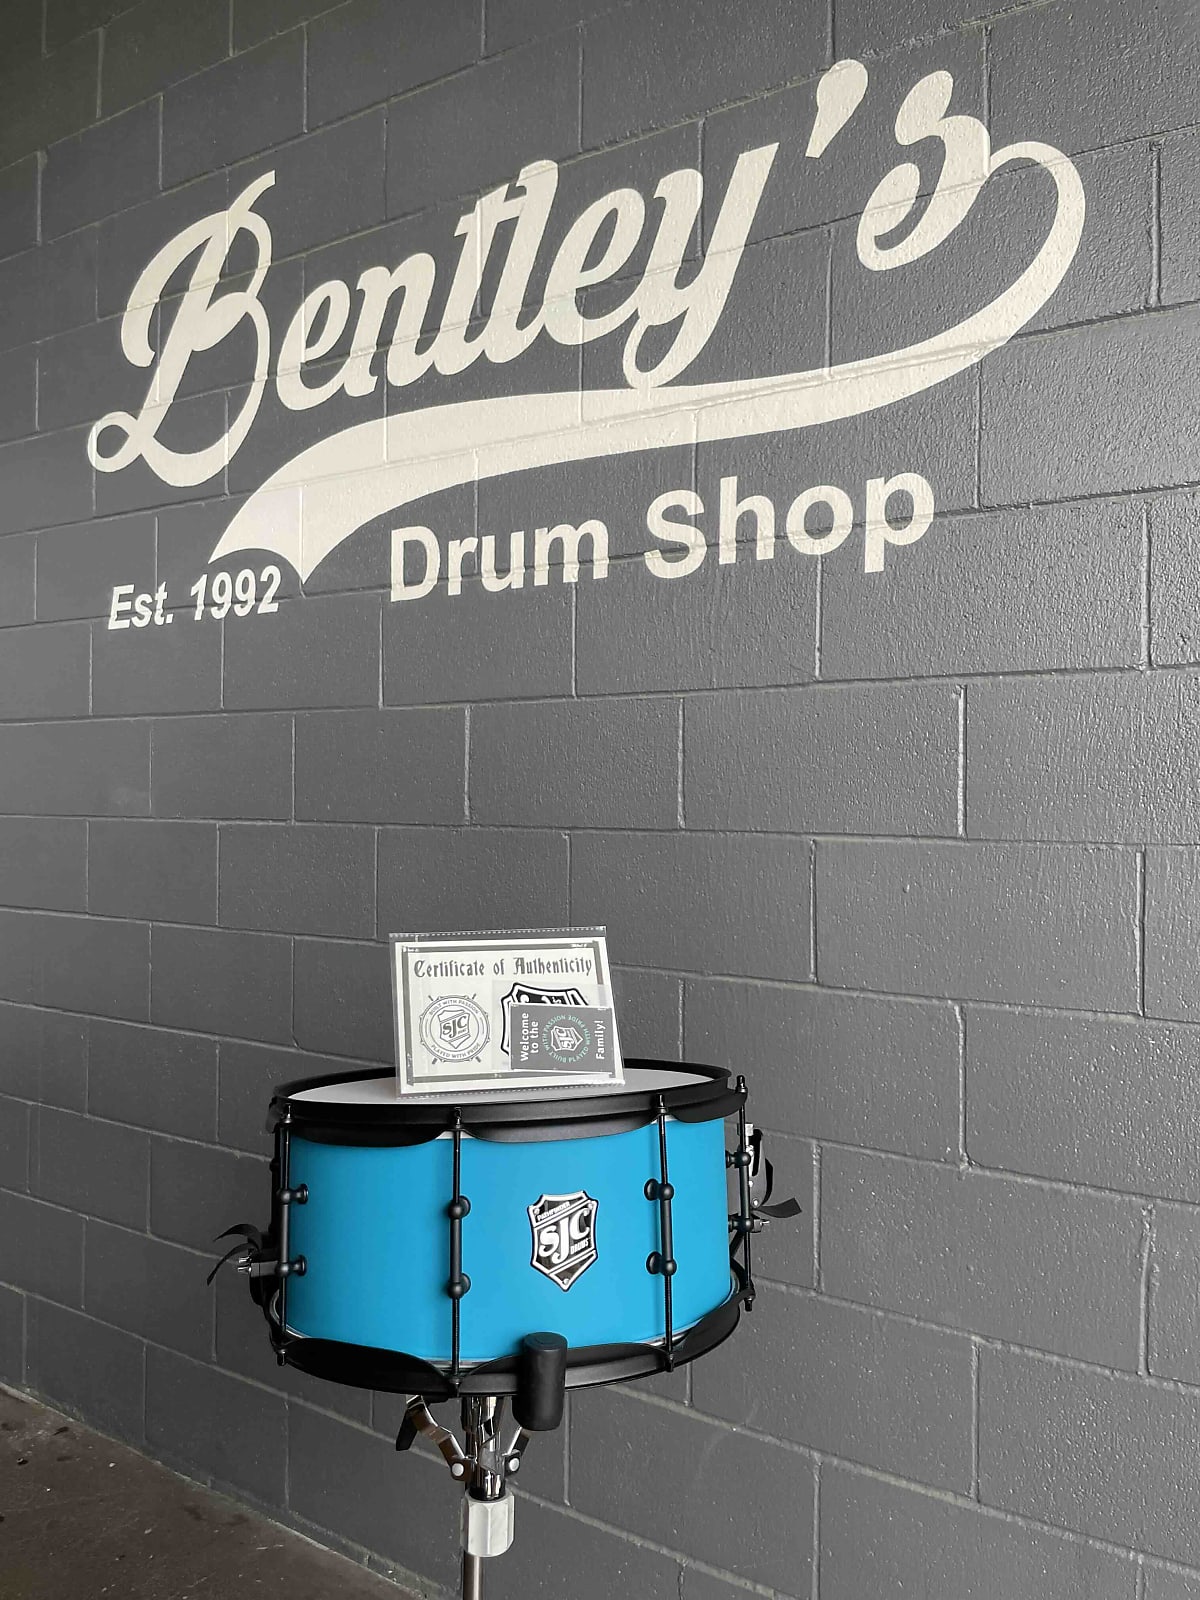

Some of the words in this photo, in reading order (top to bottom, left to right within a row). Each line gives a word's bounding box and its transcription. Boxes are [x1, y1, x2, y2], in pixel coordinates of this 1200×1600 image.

[87, 58, 1085, 487] Bentley's
[391, 519, 610, 603] Drum
[644, 470, 935, 580] Shop
[107, 581, 173, 631] Est.
[190, 565, 282, 621] 1992
[414, 959, 484, 978] Certificate
[493, 959, 504, 975] of
[513, 957, 592, 976] Authenticity
[442, 1016, 467, 1038] SJC
[520, 1012, 529, 1061] Welcome
[530, 1021, 539, 1038] the
[530, 1042, 539, 1053] to
[594, 1020, 606, 1060] Family!
[538, 1207, 590, 1264] SJC
